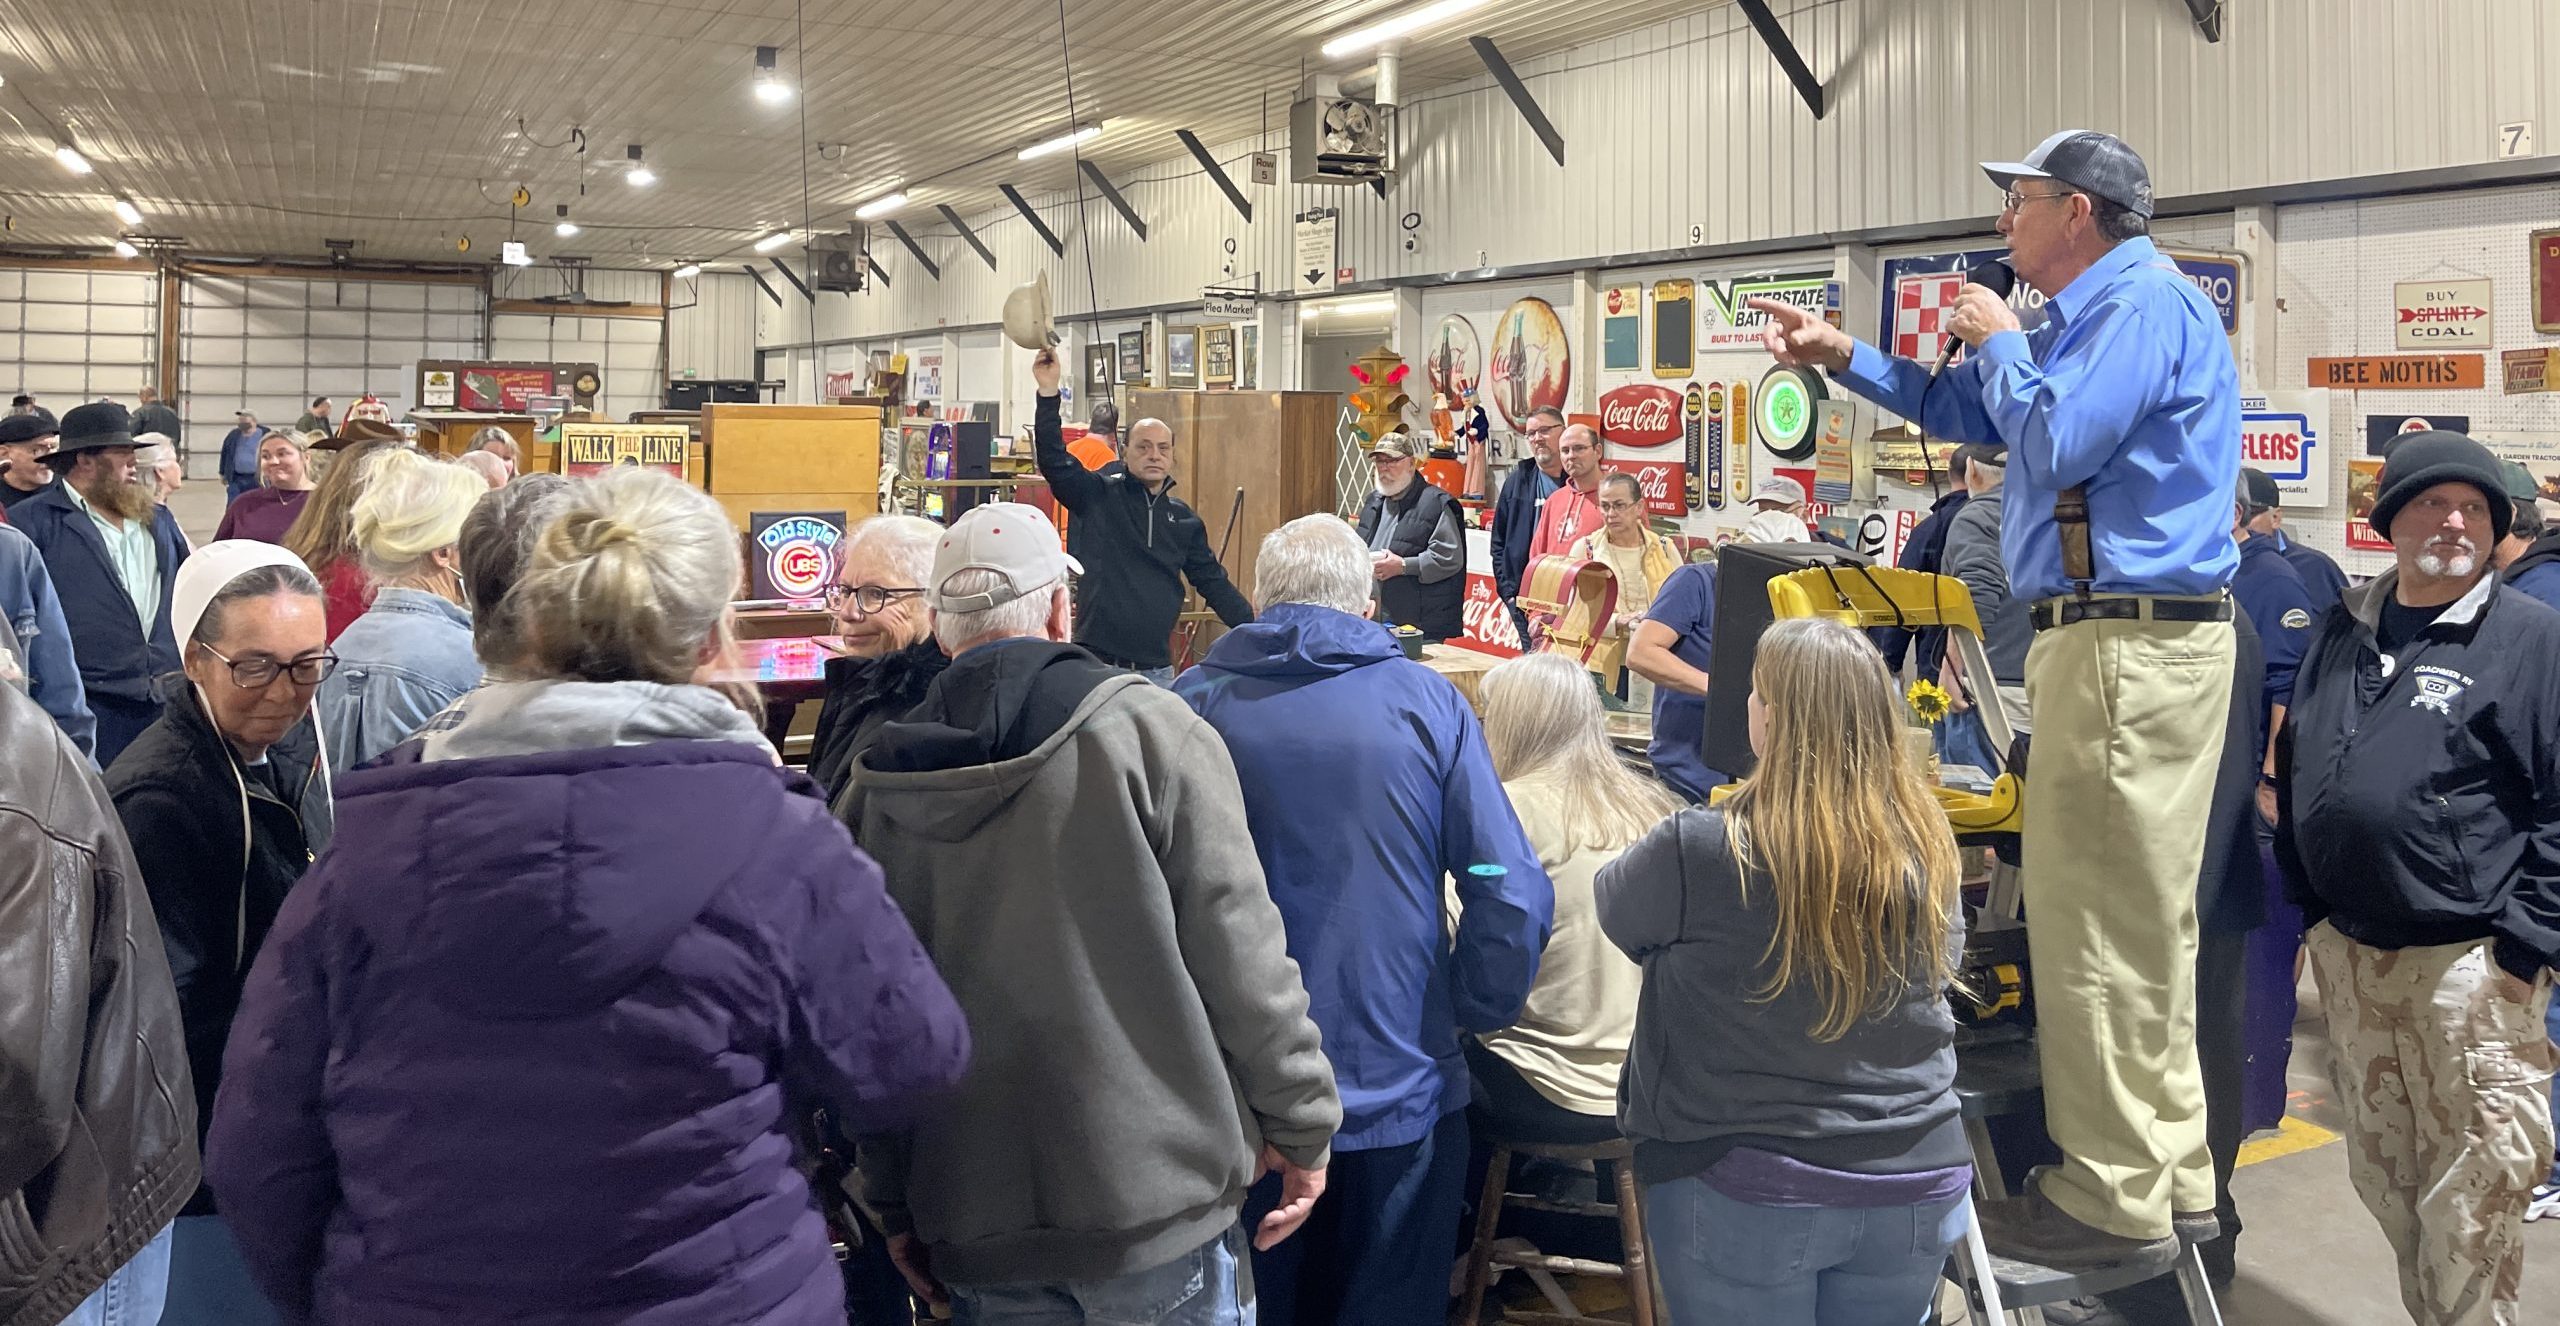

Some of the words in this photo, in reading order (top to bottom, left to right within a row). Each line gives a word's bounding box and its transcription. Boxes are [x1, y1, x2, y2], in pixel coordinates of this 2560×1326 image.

[2504, 125, 2524, 155] 7
[1256, 157, 1274, 169] Row
[1261, 170, 1268, 180] 5
[1692, 226, 1700, 243] 9
[2426, 291, 2457, 301] BUY
[1205, 302, 1222, 314] Flea
[1224, 303, 1253, 315] Market
[2417, 306, 2471, 323] SPLINT
[1711, 335, 1732, 343] BUILT
[1734, 335, 1744, 343] TO
[1745, 333, 1764, 342] LAST
[2412, 327, 2474, 337] COAL
[2329, 362, 2369, 383] BEE
[2380, 361, 2458, 383] MOTHS
[1604, 398, 1673, 432] Coca-Cola
[570, 436, 612, 463] WALK
[617, 436, 639, 453] THE
[645, 437, 680, 463] LINE
[2242, 432, 2299, 461] FLERS
[2503, 453, 2530, 461] GARDEN
[765, 524, 797, 547] Old
[796, 521, 836, 545] Style
[2352, 523, 2384, 541] Wins
[781, 547, 821, 585] CUBS
[1472, 583, 1493, 600] Enjoy
[2414, 665, 2461, 680] COACHMEN
[2461, 675, 2475, 686] RV
